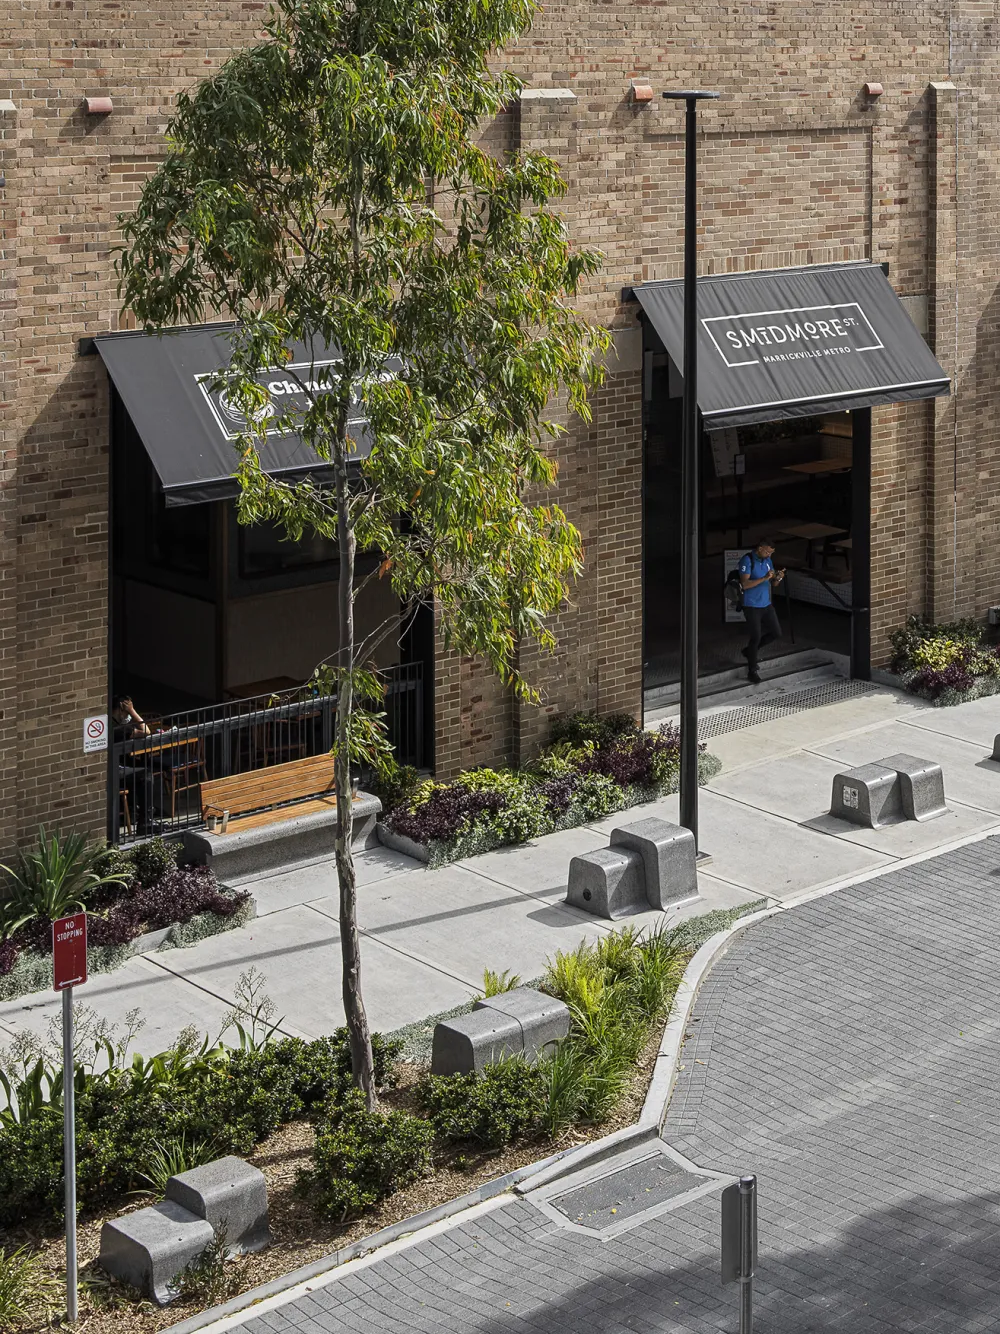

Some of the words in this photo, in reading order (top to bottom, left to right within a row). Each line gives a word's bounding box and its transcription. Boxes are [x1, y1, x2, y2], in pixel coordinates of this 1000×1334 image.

[726, 319, 848, 349] SMIDMORE
[763, 349, 822, 363] MARRICKVILLE
[823, 346, 851, 356] METRO
[65, 920, 74, 930] NO
[57, 928, 83, 942] STOPPING
